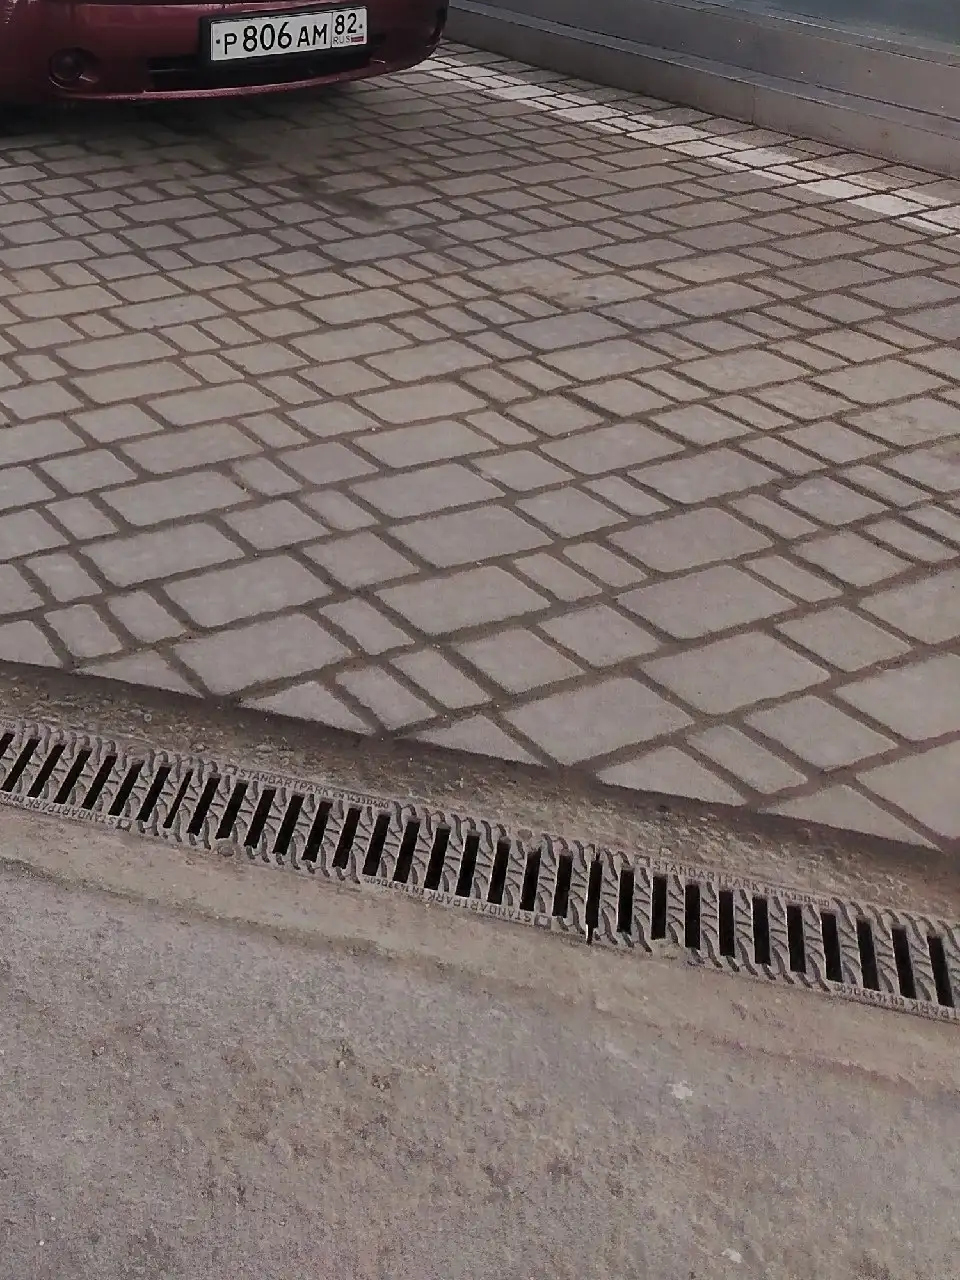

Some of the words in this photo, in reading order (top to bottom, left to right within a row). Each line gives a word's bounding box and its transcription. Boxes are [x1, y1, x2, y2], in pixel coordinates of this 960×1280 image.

[334, 12, 357, 36] 82
[333, 36, 350, 45] RUS
[239, 769, 329, 797] STANDARTPARK
[427, 892, 532, 924] STANDARTPARK
